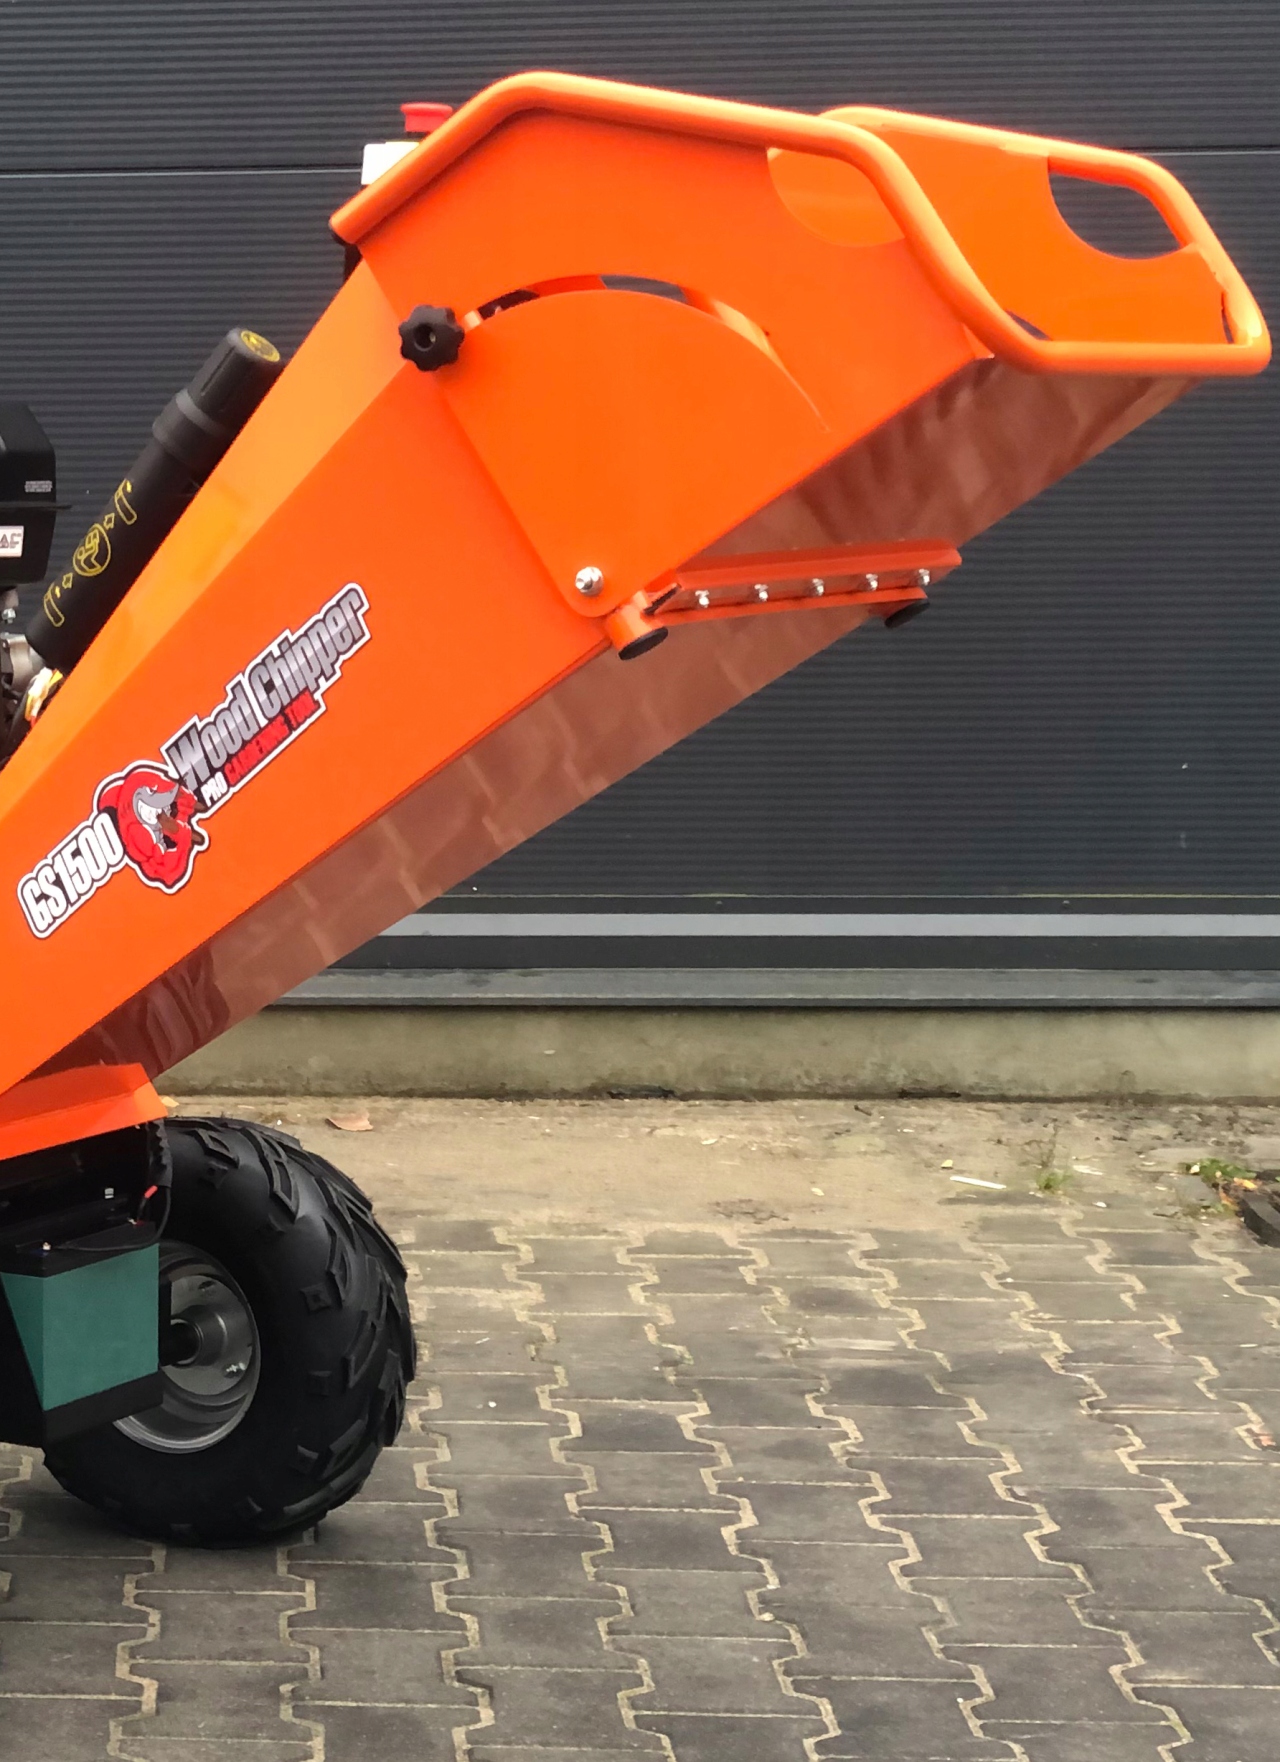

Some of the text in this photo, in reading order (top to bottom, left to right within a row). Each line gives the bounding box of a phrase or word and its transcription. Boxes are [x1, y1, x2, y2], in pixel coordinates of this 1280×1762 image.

[167, 588, 365, 790] Wood Chipper
[200, 771, 228, 806] PRO
[21, 812, 124, 933] GS1500
